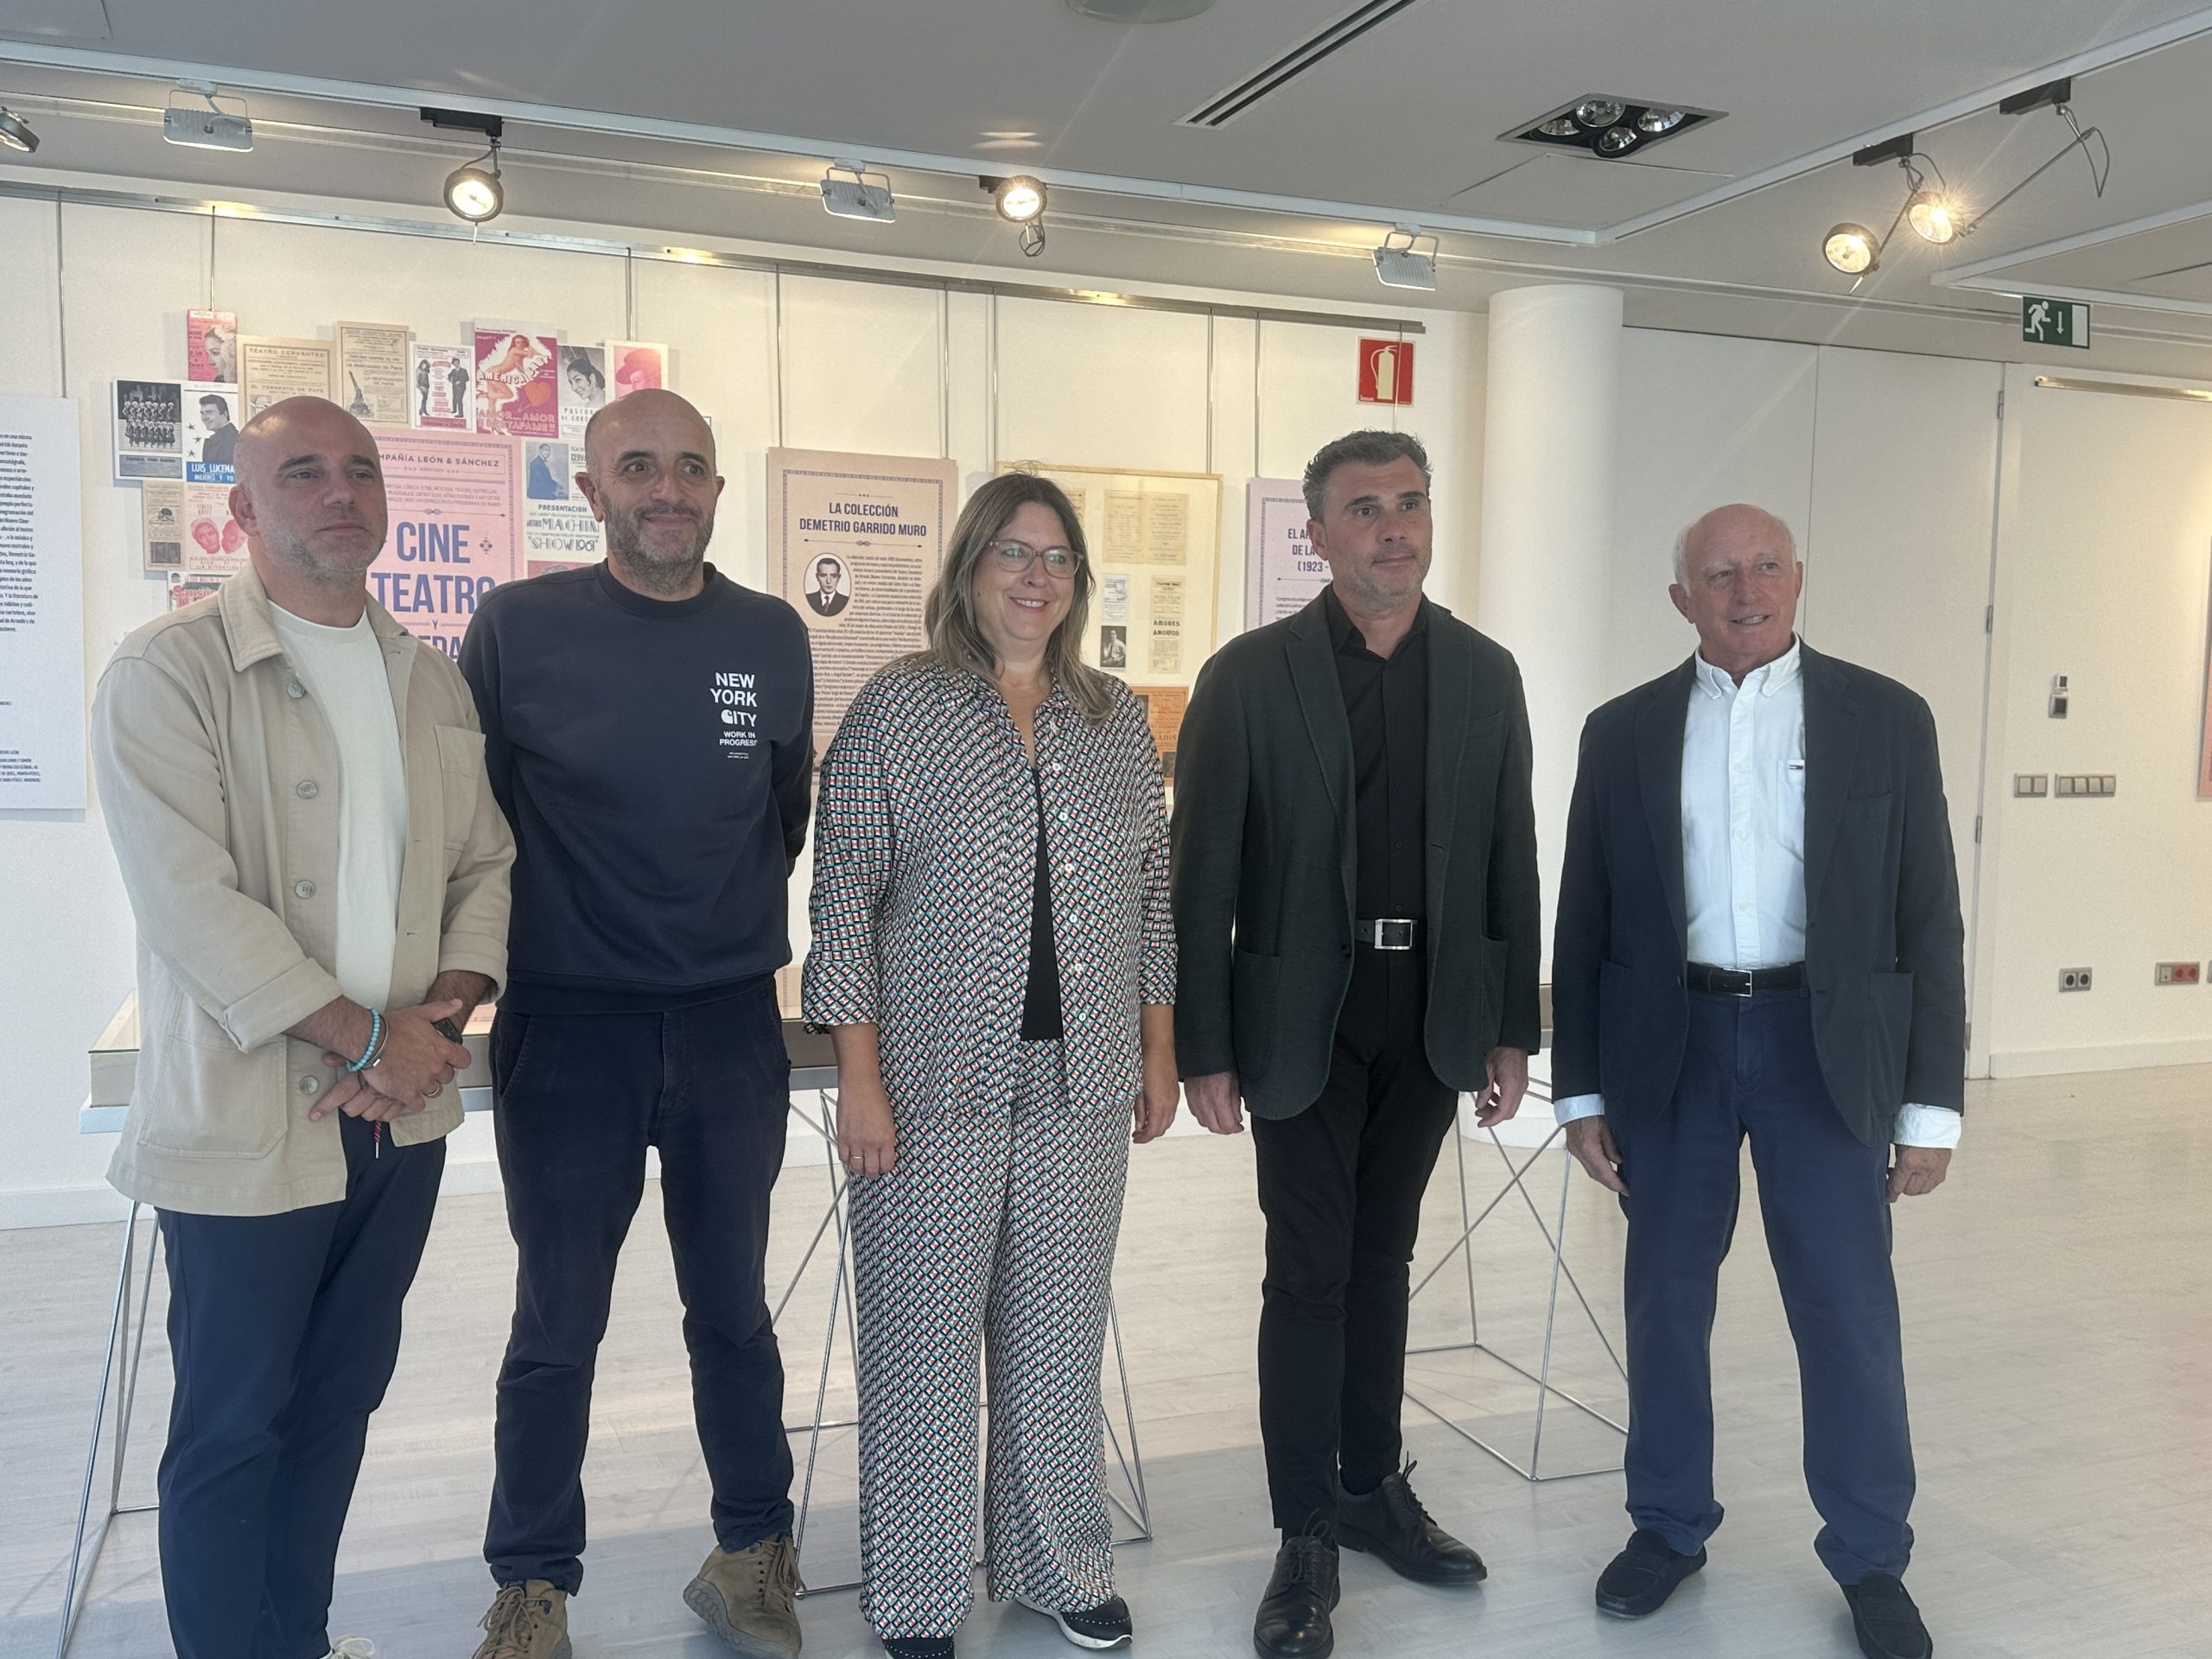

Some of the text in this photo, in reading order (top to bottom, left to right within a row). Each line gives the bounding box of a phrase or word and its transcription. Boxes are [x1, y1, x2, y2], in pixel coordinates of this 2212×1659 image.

[523, 413, 555, 423] AMOR
[192, 463, 234, 473] LUIS LUCENA
[418, 455, 442, 464] LEÓN
[456, 456, 499, 467] SÁNCHEZ
[830, 502, 898, 518] LA COLECCIÓN
[543, 518, 599, 532] MACHIN
[800, 518, 926, 537] DEMETRIO GARRIDO MURO
[1288, 529, 1297, 538] EL
[396, 521, 470, 563] CINE
[1293, 545, 1315, 556] DE LA
[1298, 562, 1323, 572] (1923
[371, 572, 496, 614] TEATRO
[432, 620, 437, 629] Y
[715, 672, 754, 688] NEW
[709, 689, 757, 707] YORK
[721, 709, 757, 727] CITY
